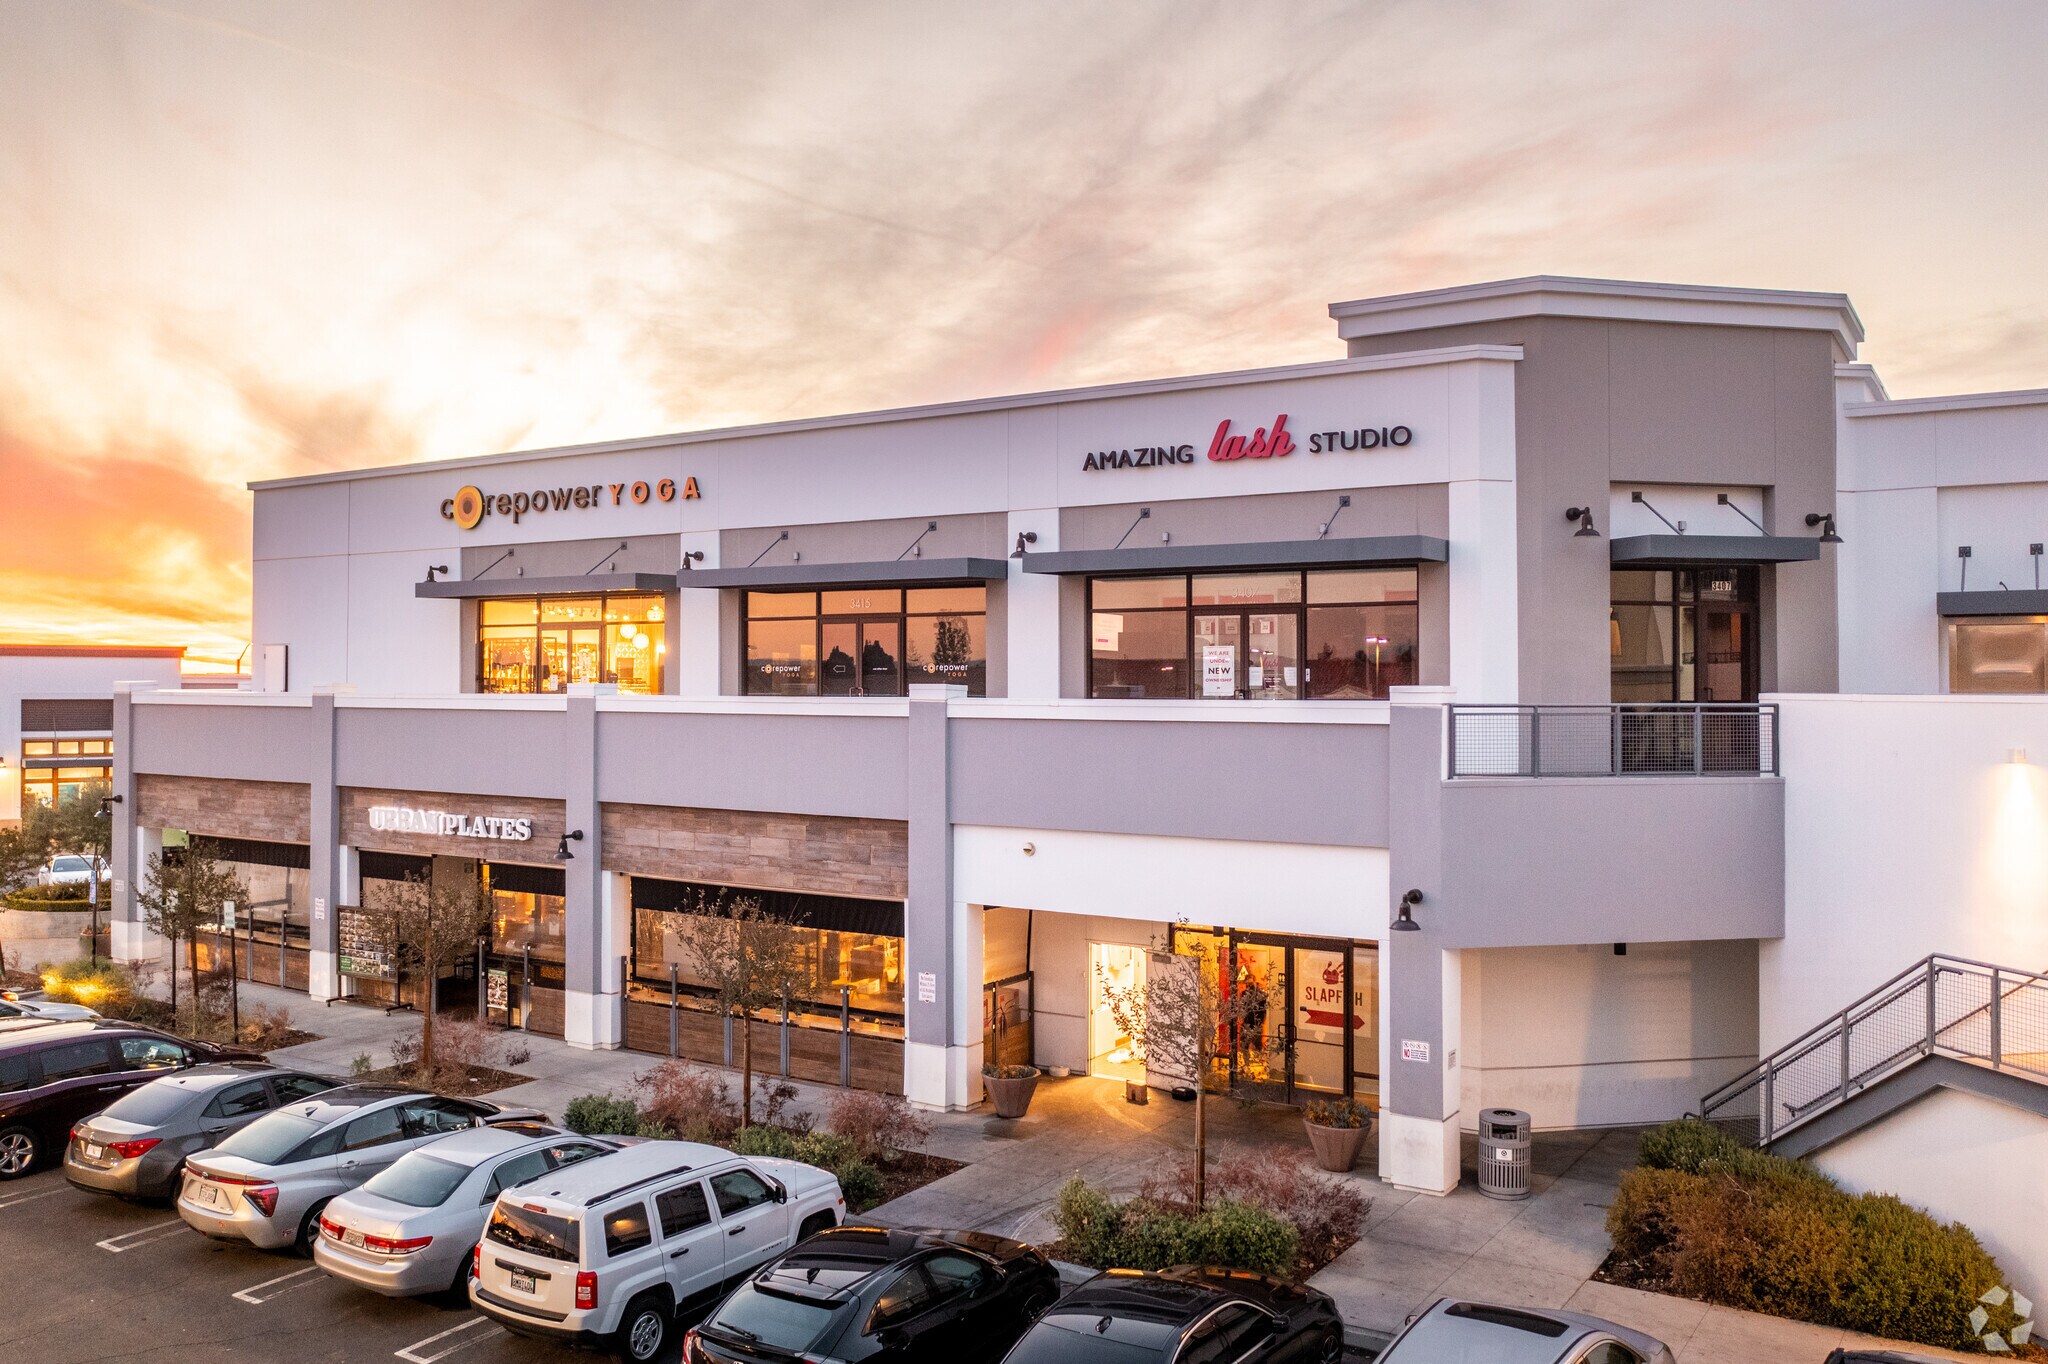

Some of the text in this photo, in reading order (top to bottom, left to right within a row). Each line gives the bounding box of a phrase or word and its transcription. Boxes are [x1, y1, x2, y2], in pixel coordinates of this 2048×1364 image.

[1082, 413, 1413, 472] AMAZING lash STUDIO
[440, 476, 702, 530] corepower YOGA
[1711, 580, 1731, 591] 3407
[761, 663, 801, 674] corepower
[922, 662, 969, 674] corepower
[1208, 667, 1231, 675] NEW
[443, 814, 532, 841] PLATES
[1305, 986, 1363, 1006] SLAPFH
